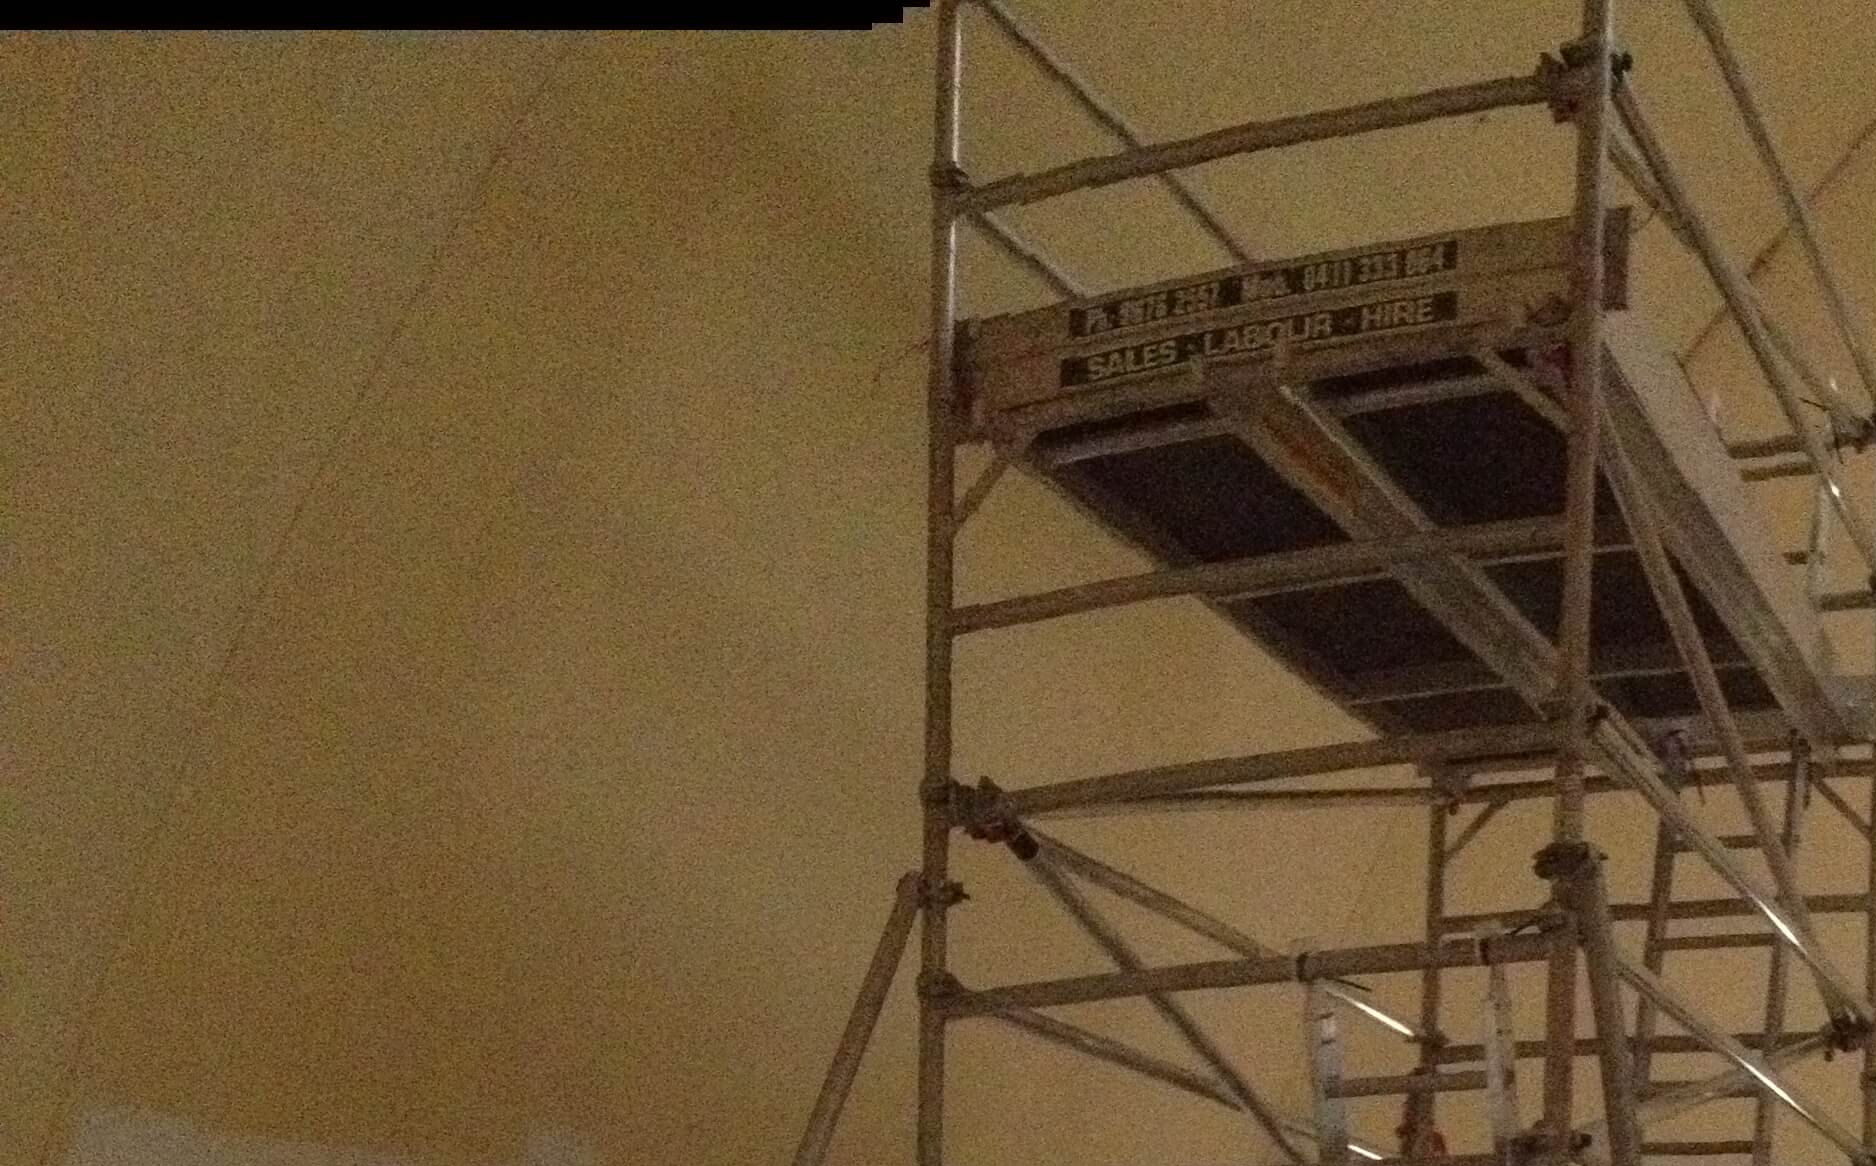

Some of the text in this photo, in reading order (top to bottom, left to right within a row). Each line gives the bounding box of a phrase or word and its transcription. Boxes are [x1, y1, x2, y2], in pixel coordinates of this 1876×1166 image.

[1303, 259, 1352, 292] 0411
[1359, 253, 1399, 283] 333
[1088, 340, 1177, 380] SALES
[1204, 314, 1333, 356] LABOUR
[1360, 297, 1434, 331] HIRE
